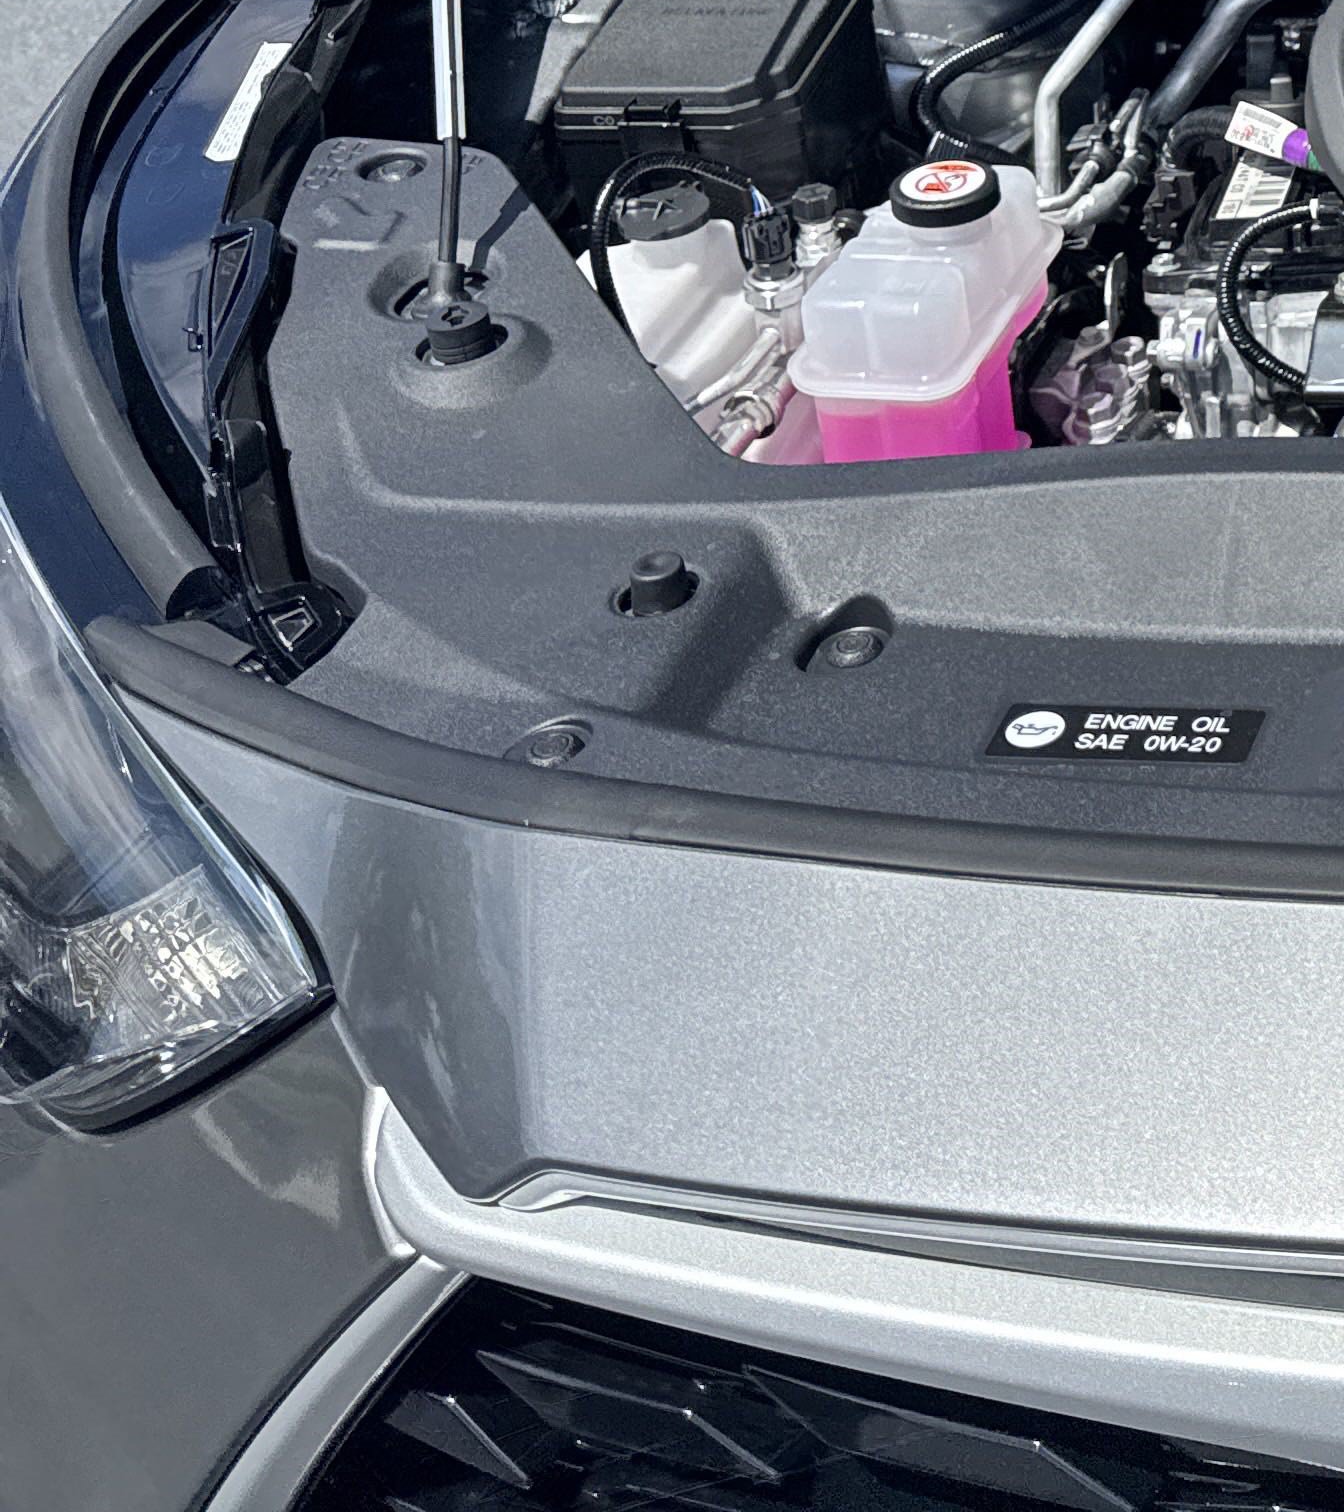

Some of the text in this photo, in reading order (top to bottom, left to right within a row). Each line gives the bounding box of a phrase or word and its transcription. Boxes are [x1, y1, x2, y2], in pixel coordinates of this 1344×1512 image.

[1084, 713, 1230, 733] ENGINE OIL
[1074, 733, 1222, 753] SAE 0W-20
